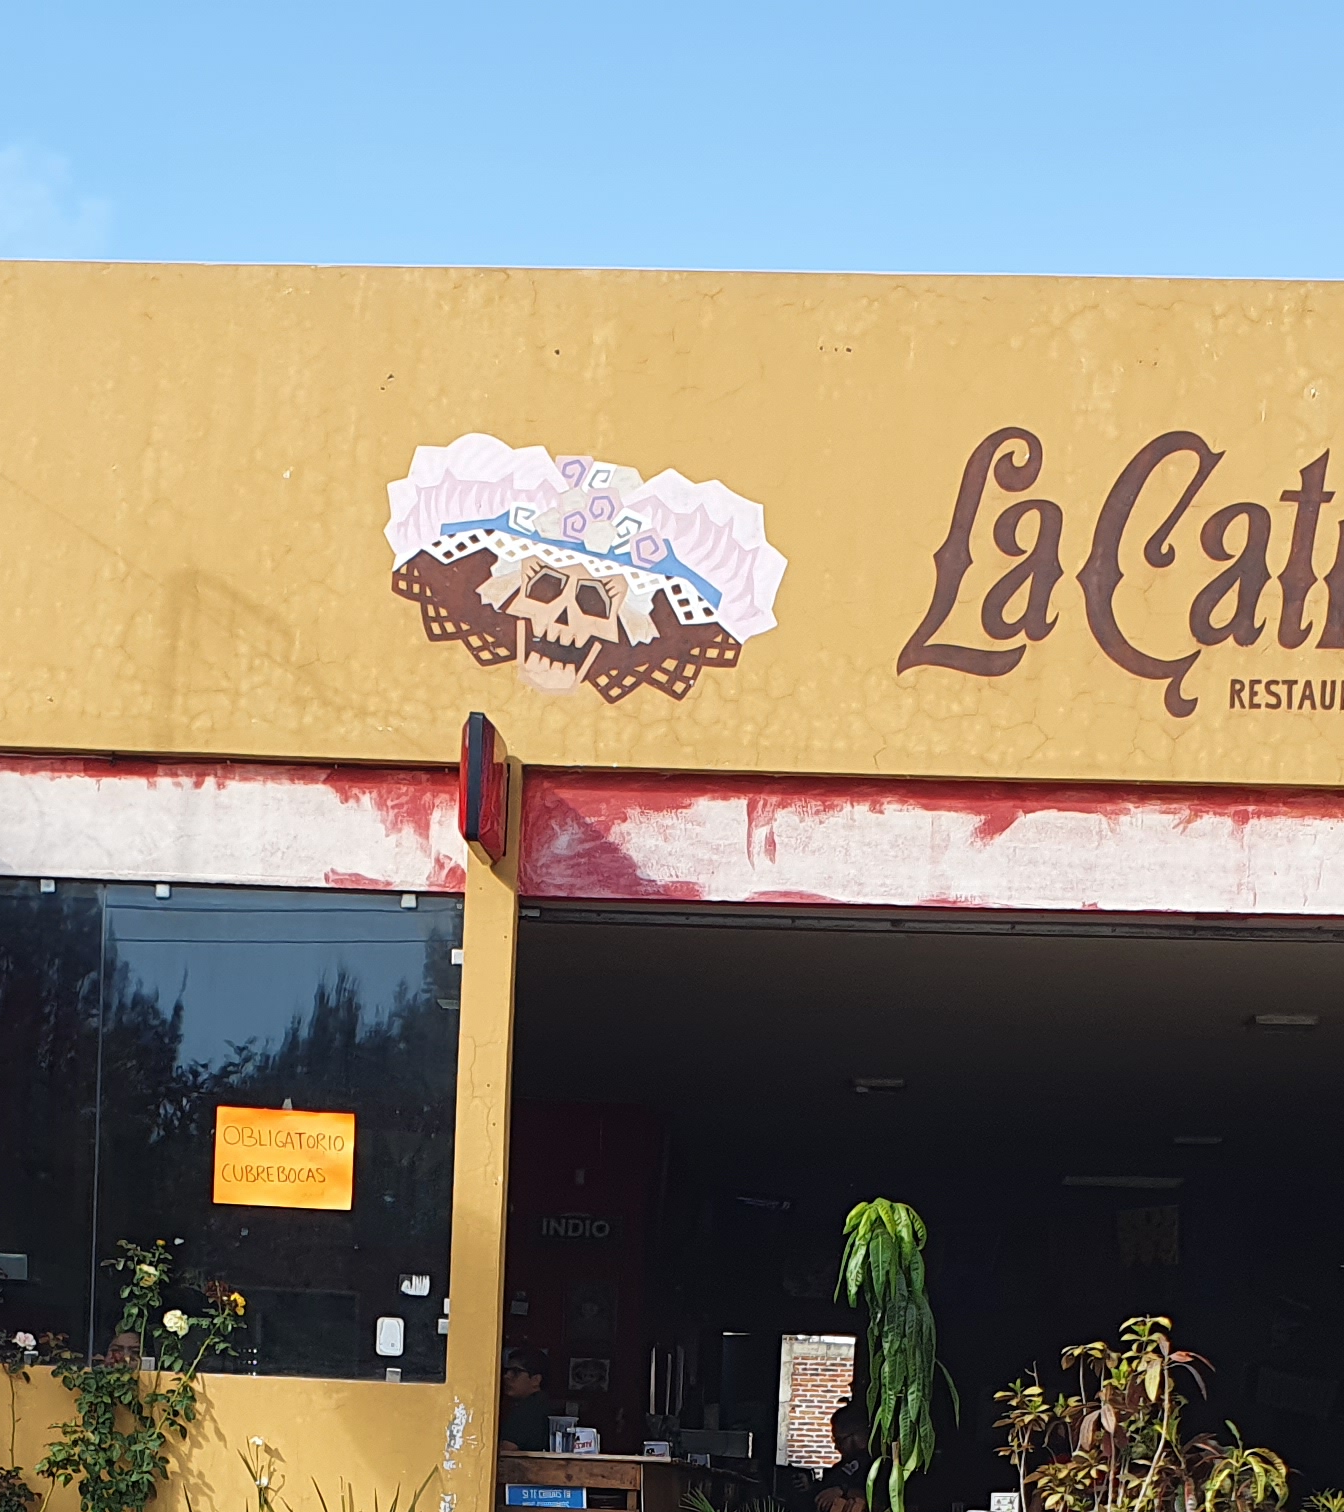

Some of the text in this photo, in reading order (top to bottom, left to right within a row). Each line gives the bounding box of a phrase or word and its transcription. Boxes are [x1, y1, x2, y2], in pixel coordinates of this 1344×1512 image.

[896, 426, 1064, 678] La
[223, 1125, 344, 1152] OBLIGATORIO
[221, 1163, 326, 1184] CUBREBOCAS
[541, 1218, 610, 1238] INDIO
